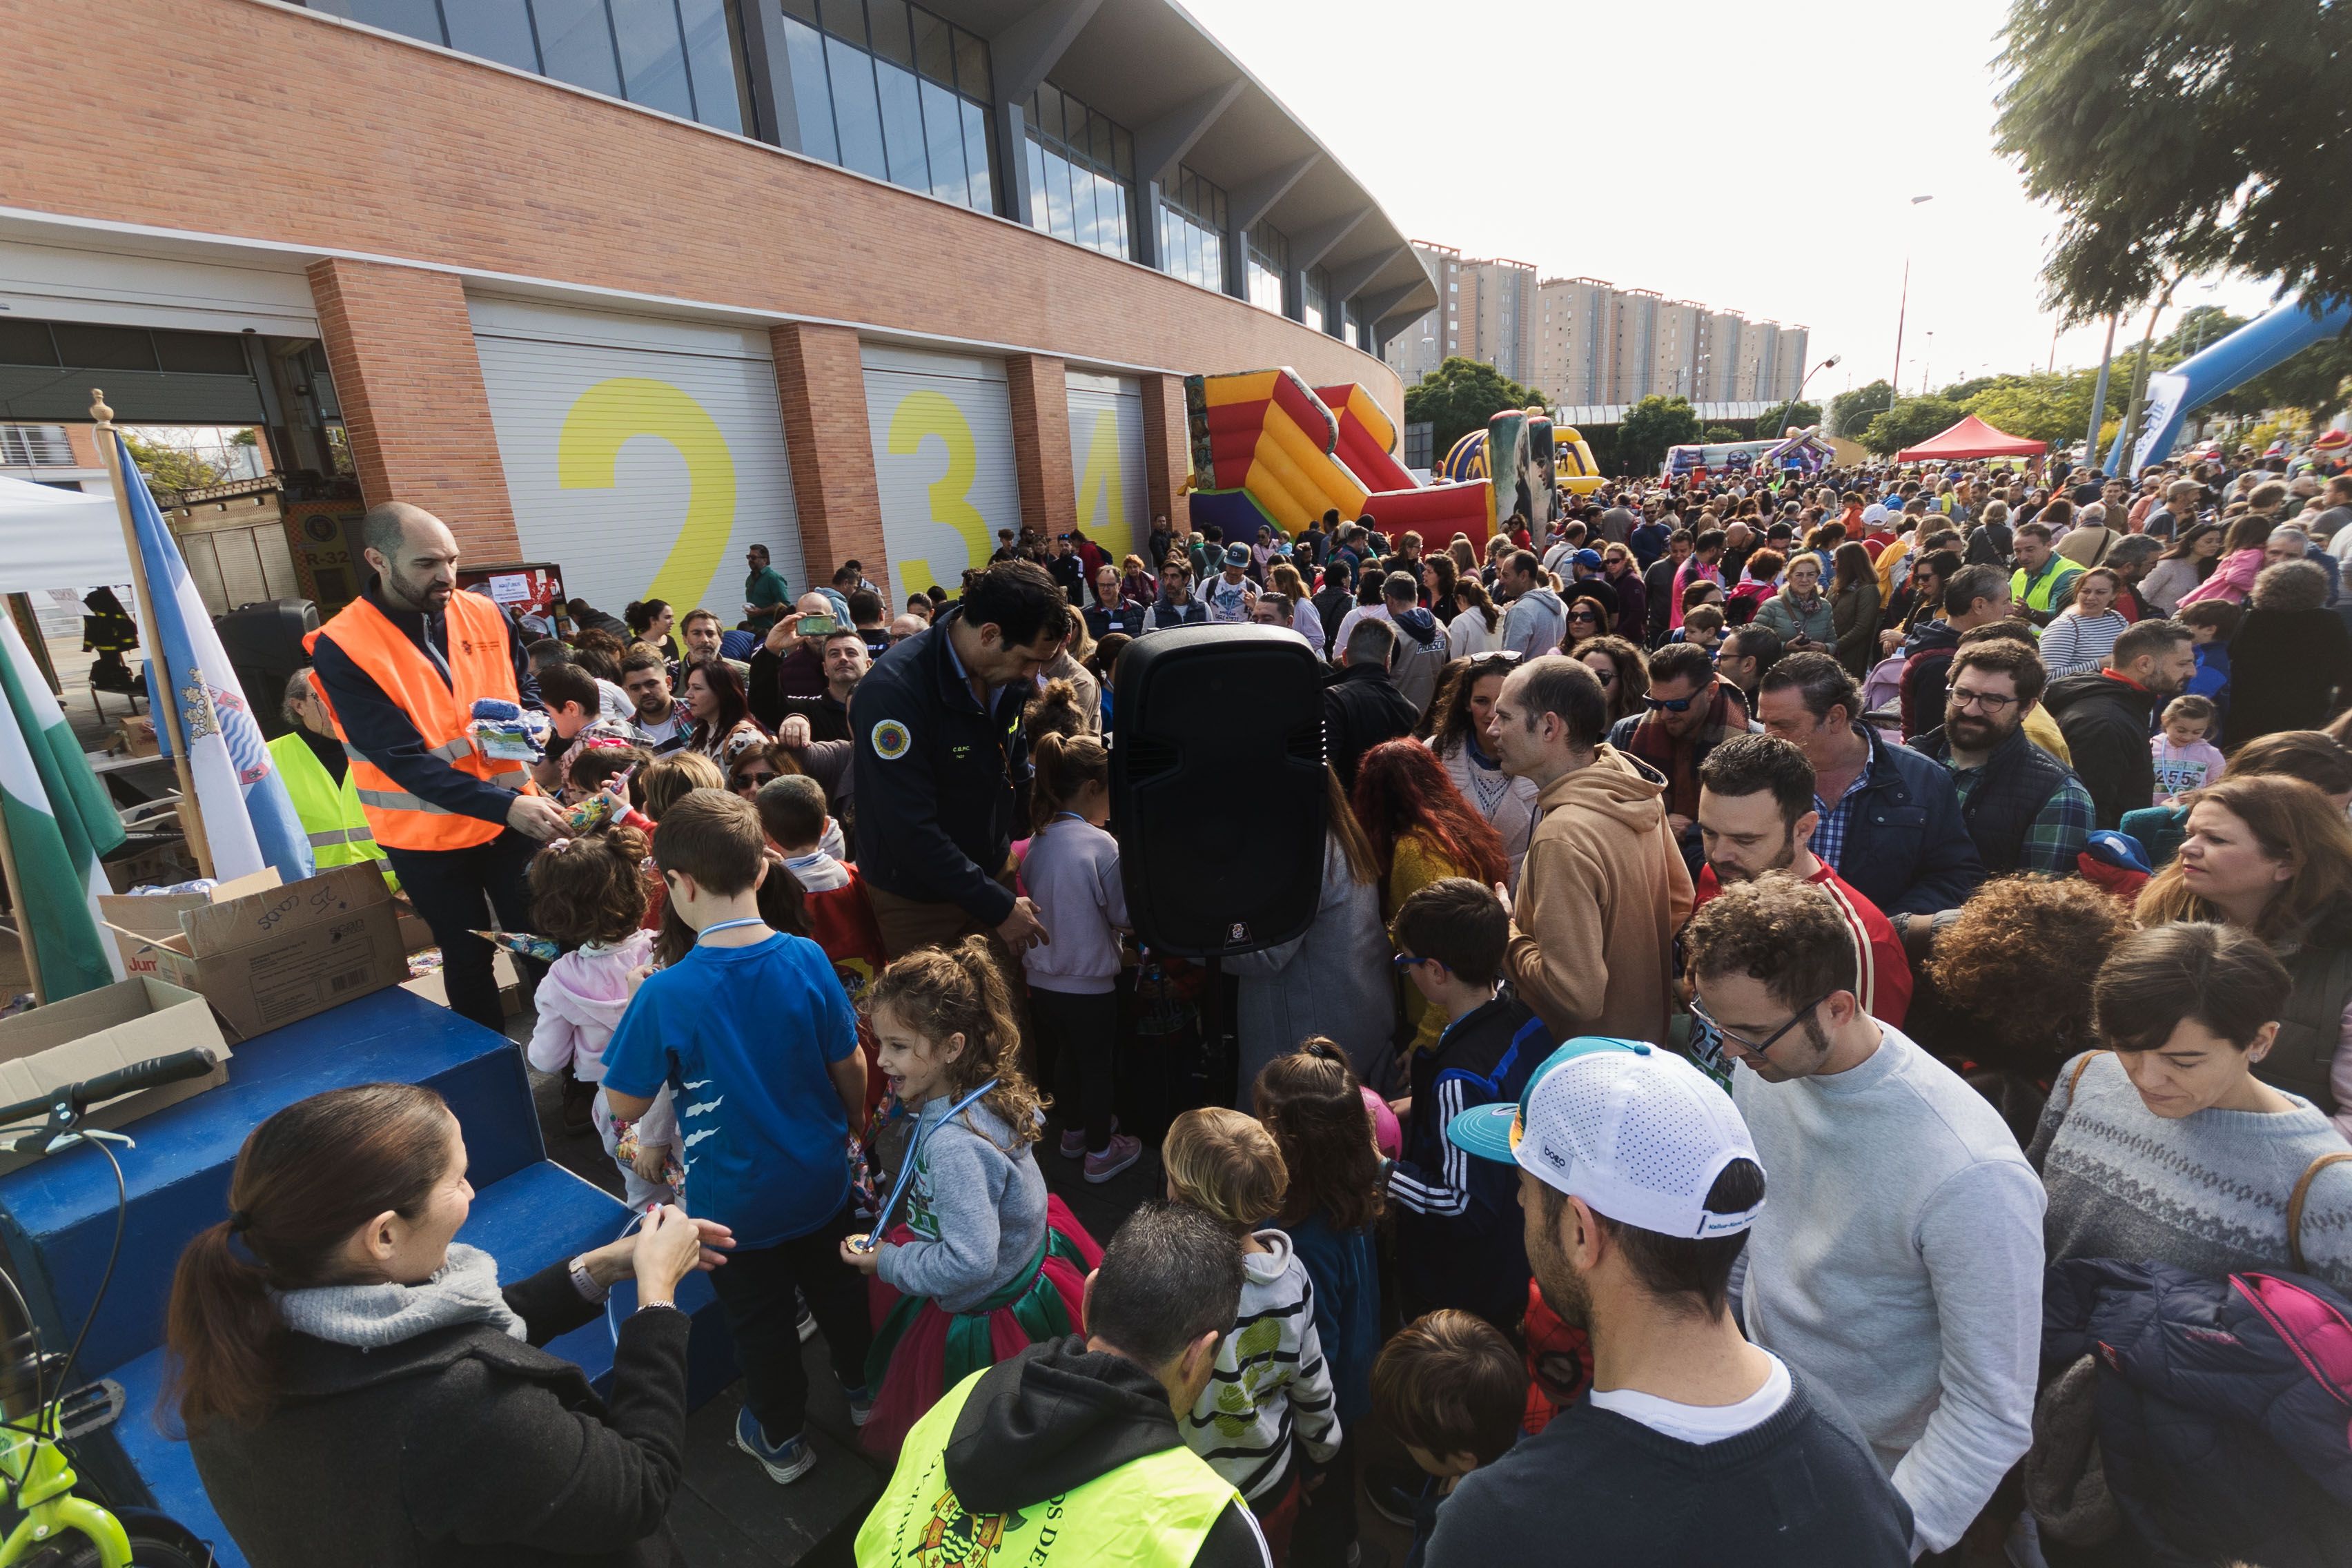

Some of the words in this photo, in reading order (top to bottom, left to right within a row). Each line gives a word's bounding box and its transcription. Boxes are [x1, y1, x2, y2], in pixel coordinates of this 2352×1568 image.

[558, 377, 736, 642] 2
[888, 390, 993, 599] 3
[1075, 409, 1133, 567] 4
[1690, 1017, 1723, 1064] 27
[1544, 1144, 1566, 1167] boco
[1028, 1524, 1059, 1568] DE
